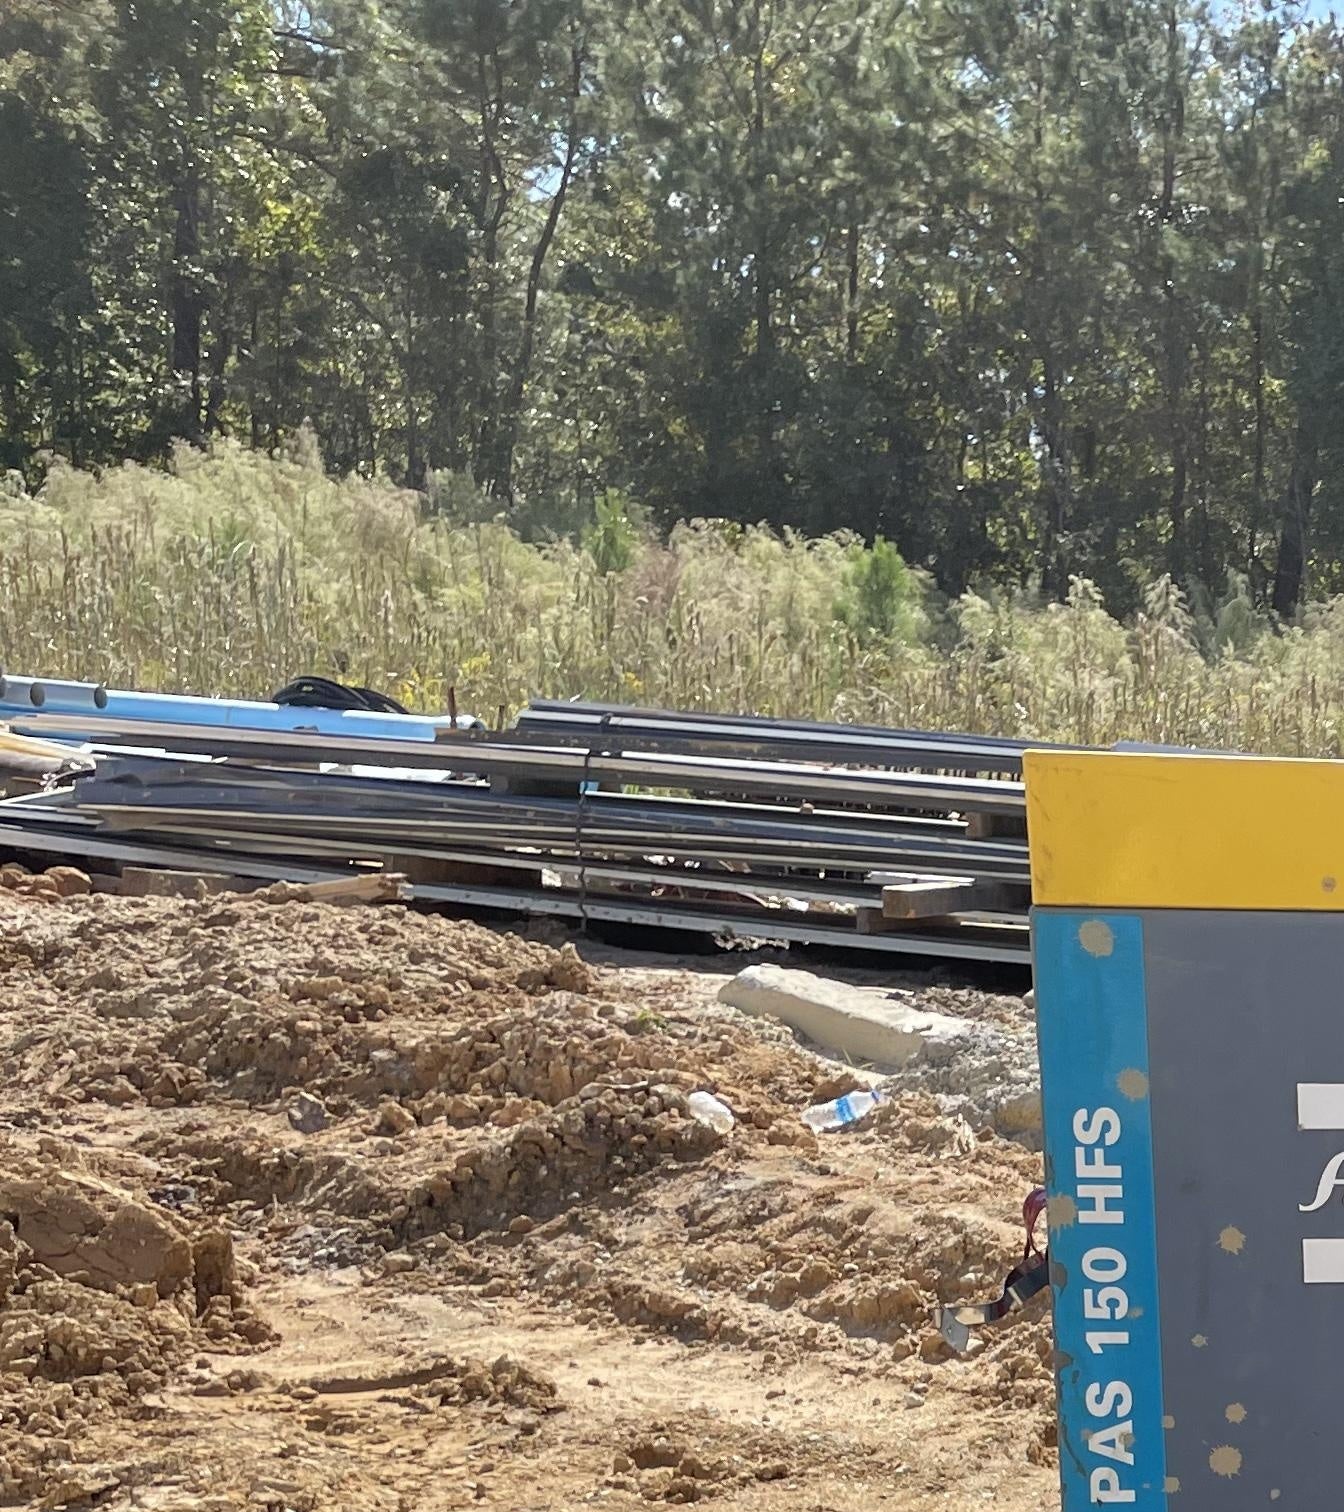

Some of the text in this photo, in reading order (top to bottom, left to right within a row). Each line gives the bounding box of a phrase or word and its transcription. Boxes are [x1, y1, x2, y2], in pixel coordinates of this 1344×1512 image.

[1072, 1106, 1136, 1504] PAS 150 HFS
